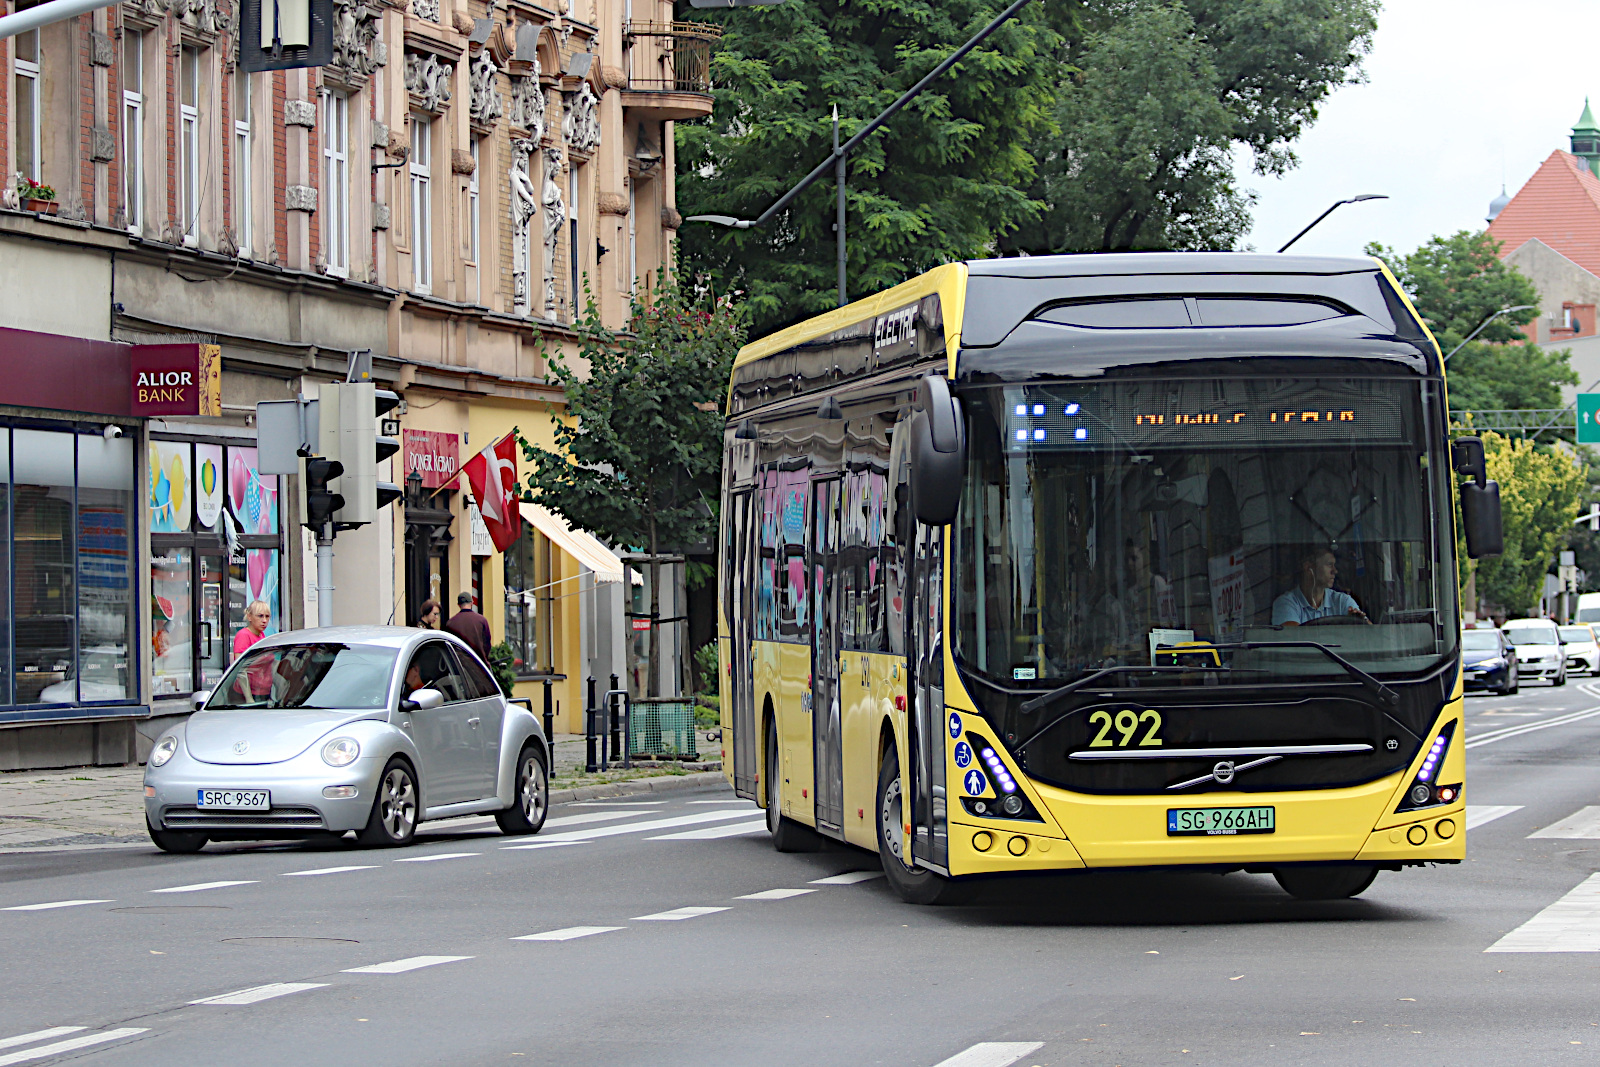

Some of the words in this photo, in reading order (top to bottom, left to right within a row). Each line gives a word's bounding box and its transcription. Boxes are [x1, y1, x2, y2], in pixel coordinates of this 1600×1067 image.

[875, 305, 918, 348] ELECTRIC
[137, 372, 192, 386] ALIOR
[139, 388, 184, 402] BANK
[1089, 710, 1162, 747] 292
[205, 792, 231, 805] SRC
[236, 792, 266, 806] 9S67
[1181, 811, 1205, 829] SG
[1212, 810, 1269, 829] 966AH
